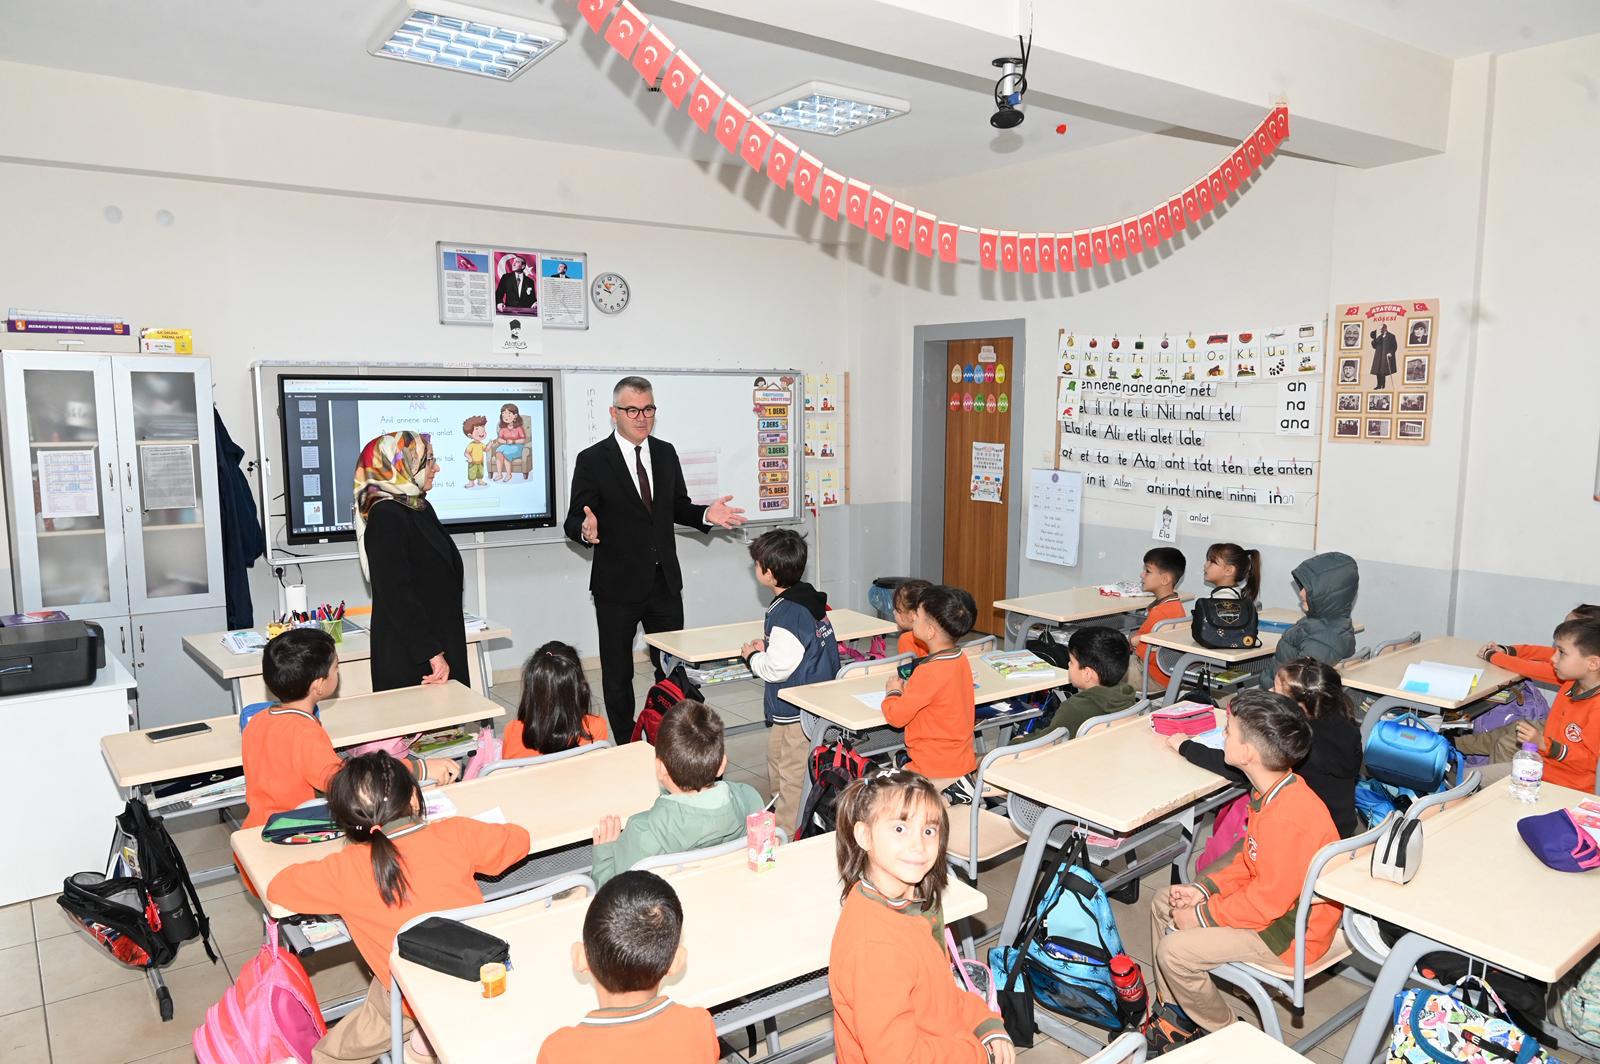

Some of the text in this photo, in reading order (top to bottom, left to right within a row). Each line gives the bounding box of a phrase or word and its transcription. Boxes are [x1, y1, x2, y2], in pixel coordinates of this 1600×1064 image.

[1122, 383, 1152, 393] nane
[1154, 384, 1186, 394] anne
[1190, 384, 1211, 396] net
[1288, 382, 1306, 392] an
[1109, 402, 1119, 416] la
[1124, 402, 1133, 417] le
[1158, 404, 1176, 420] Nil
[1186, 405, 1205, 420] nal
[1218, 406, 1235, 420] tel
[1286, 400, 1306, 410] na
[1280, 419, 1310, 429] ana
[1086, 422, 1096, 437] ile
[1104, 424, 1120, 440] Ali
[1127, 427, 1146, 442] etli
[1150, 428, 1172, 444] alet
[1180, 430, 1202, 446] lale
[1062, 448, 1312, 475] at et ta te Ata ant tat ten ete anten
[1086, 474, 1096, 484] in
[1099, 476, 1106, 488] it
[1147, 484, 1165, 494] ani
[1168, 484, 1190, 496] inat
[1196, 487, 1222, 499] nine
[1230, 492, 1256, 502] ninni
[1159, 530, 1170, 538] Ela
